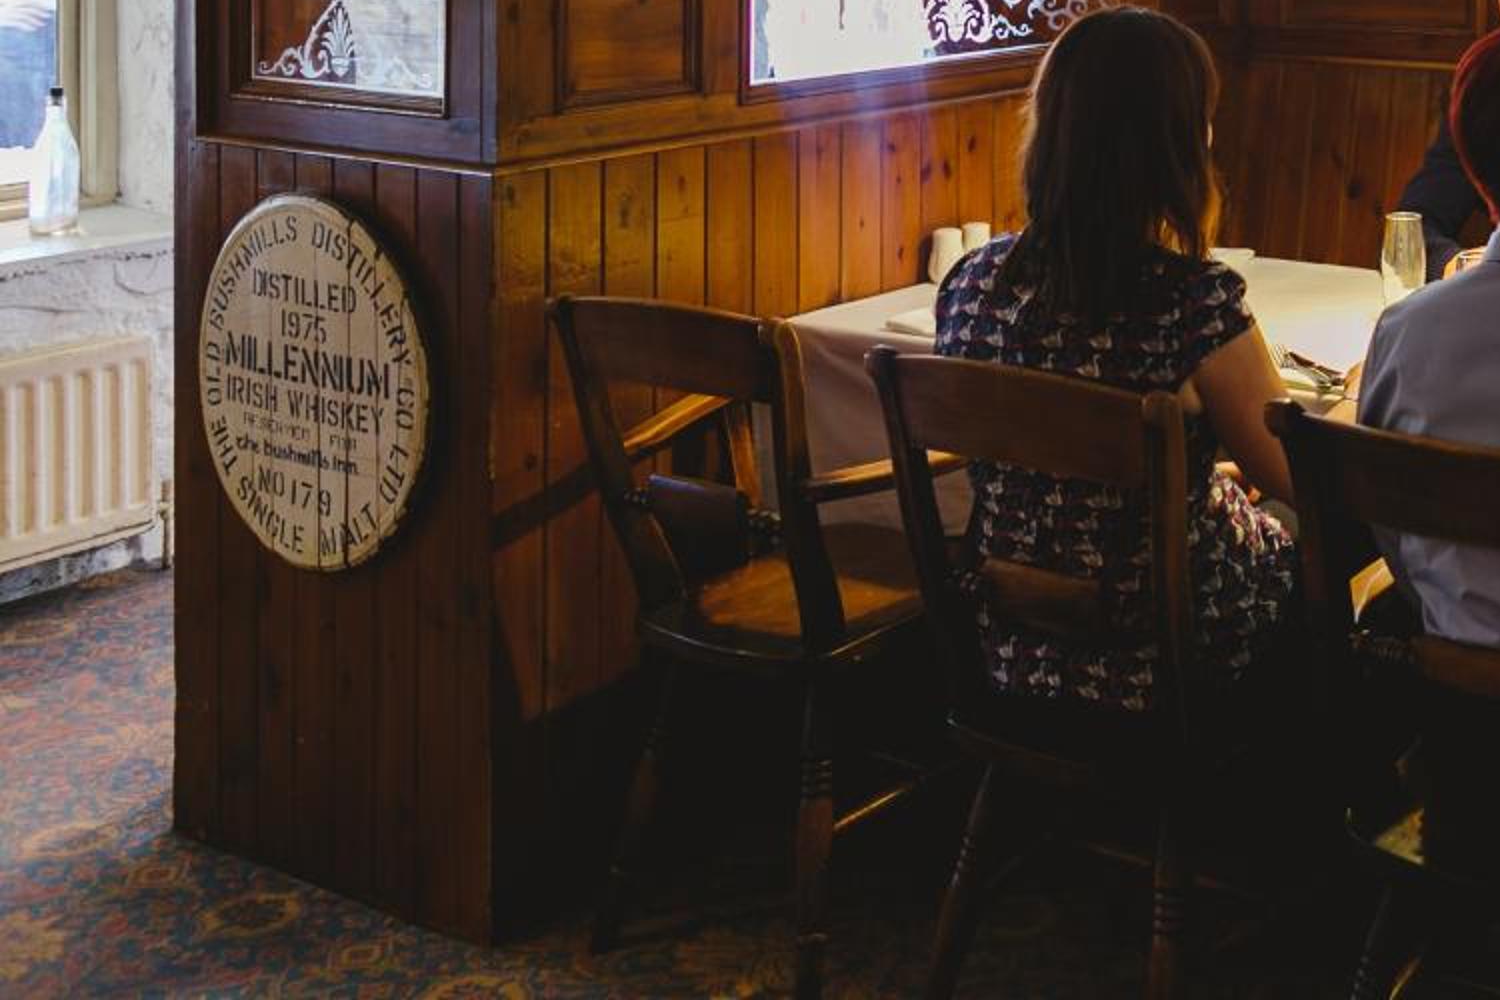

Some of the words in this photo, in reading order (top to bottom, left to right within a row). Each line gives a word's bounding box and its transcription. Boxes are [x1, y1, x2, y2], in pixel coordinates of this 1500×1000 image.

[210, 215, 298, 333] BUSHMILLS
[252, 268, 357, 313] DISTILLED
[311, 222, 413, 368] DISTILLERY
[281, 309, 327, 345] 1975
[206, 343, 223, 406] OLD
[225, 331, 391, 399] MILLENNIUM
[226, 374, 278, 415] IRISH
[287, 390, 384, 435] WHISKEY
[395, 385, 416, 431] CO
[210, 417, 241, 477] THE
[235, 436, 261, 456] the
[257, 466, 286, 498] NO
[378, 451, 410, 504] LTD
[236, 476, 305, 554] SINGLE
[319, 503, 378, 559] MALT
